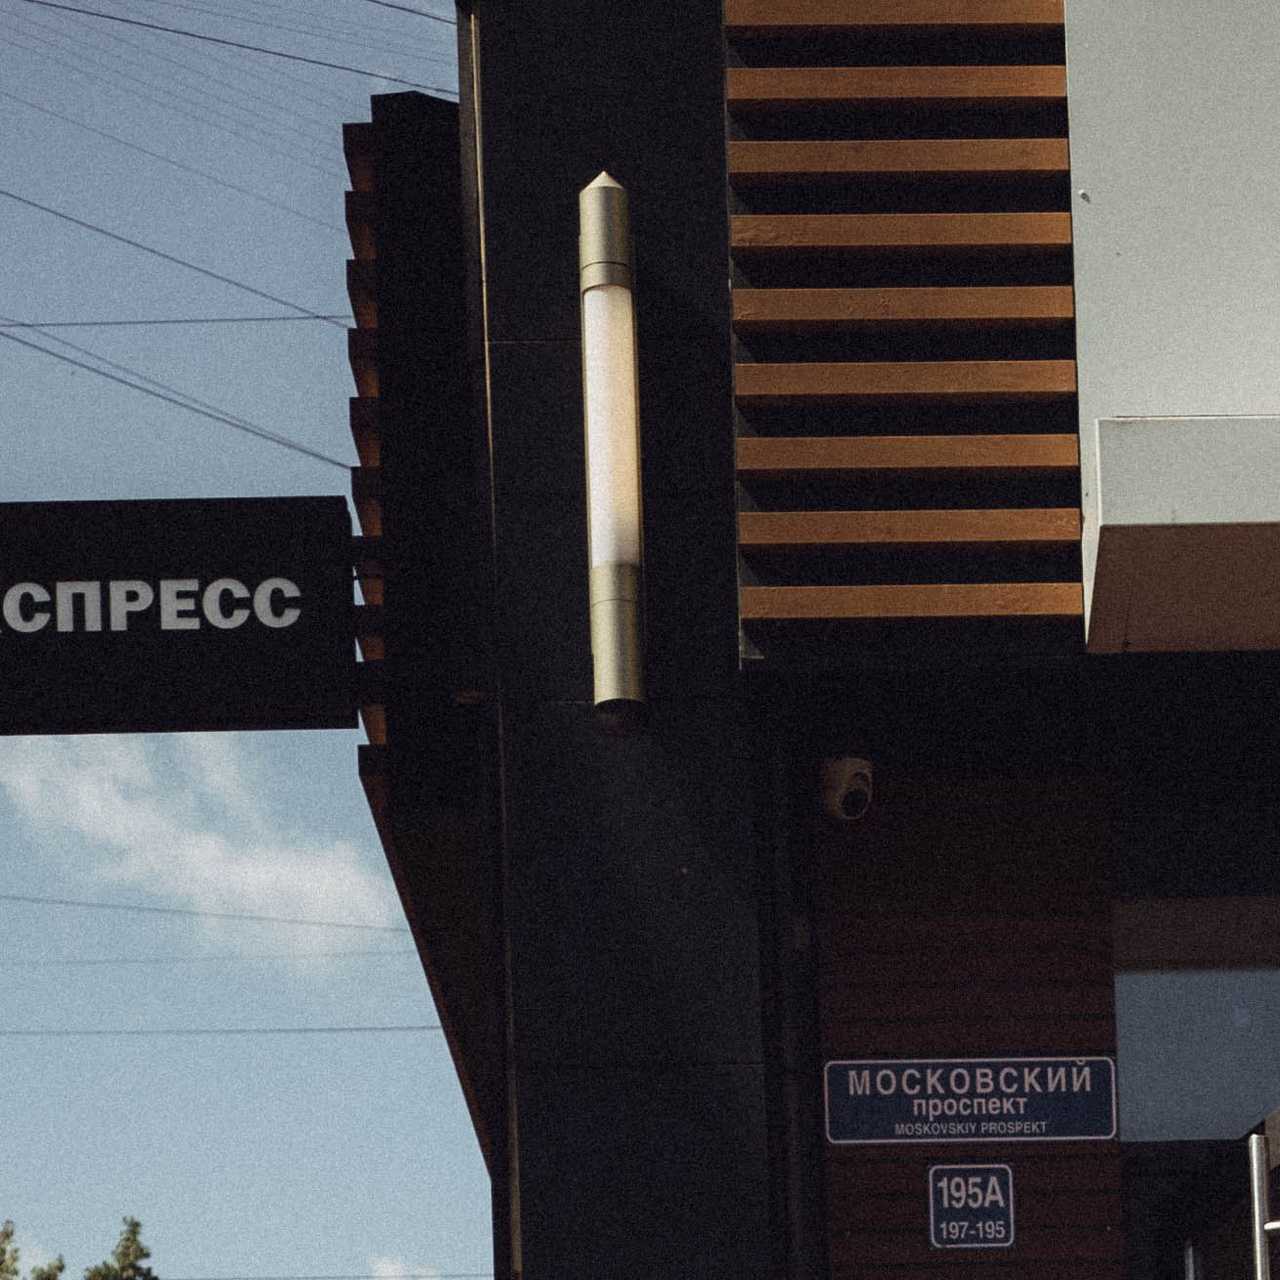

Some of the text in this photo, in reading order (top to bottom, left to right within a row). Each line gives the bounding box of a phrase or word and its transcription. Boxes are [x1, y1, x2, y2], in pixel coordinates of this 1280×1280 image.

[2, 577, 301, 633] СПРЕСС
[849, 1059, 1092, 1095] МОСКОВСКИЙ
[912, 1097, 1028, 1121] проспект
[895, 1121, 1048, 1135] MOSKOVSKIY PROSPEKT
[937, 1176, 1005, 1209] 195А
[939, 1220, 1005, 1240] 197-195
